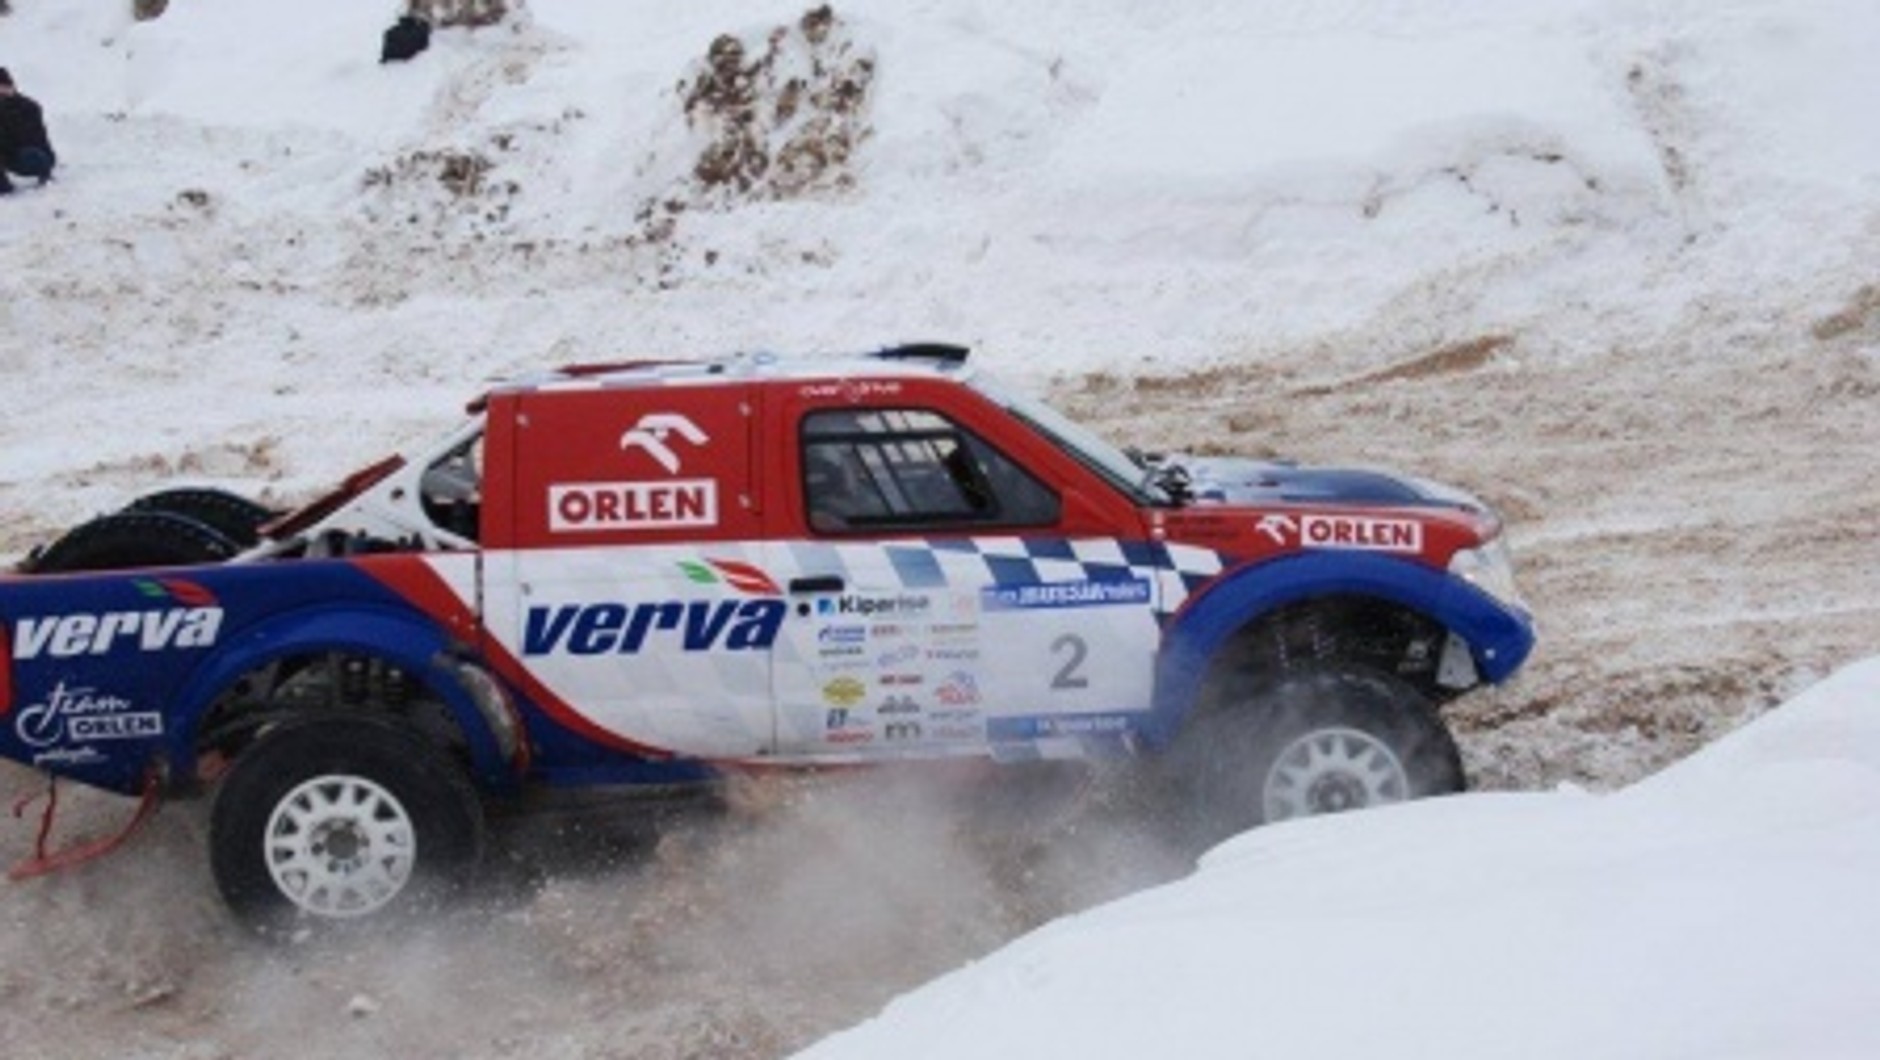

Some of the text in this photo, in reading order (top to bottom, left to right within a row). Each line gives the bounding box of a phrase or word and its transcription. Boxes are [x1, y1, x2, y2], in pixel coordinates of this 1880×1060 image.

[558, 488, 706, 523] ORLEN
[1309, 519, 1413, 546] ORLEN
[12, 606, 224, 660] verva
[522, 599, 788, 657] verva
[1050, 633, 1089, 690] 2
[36, 678, 131, 732] team
[75, 716, 157, 735] ORLEN
